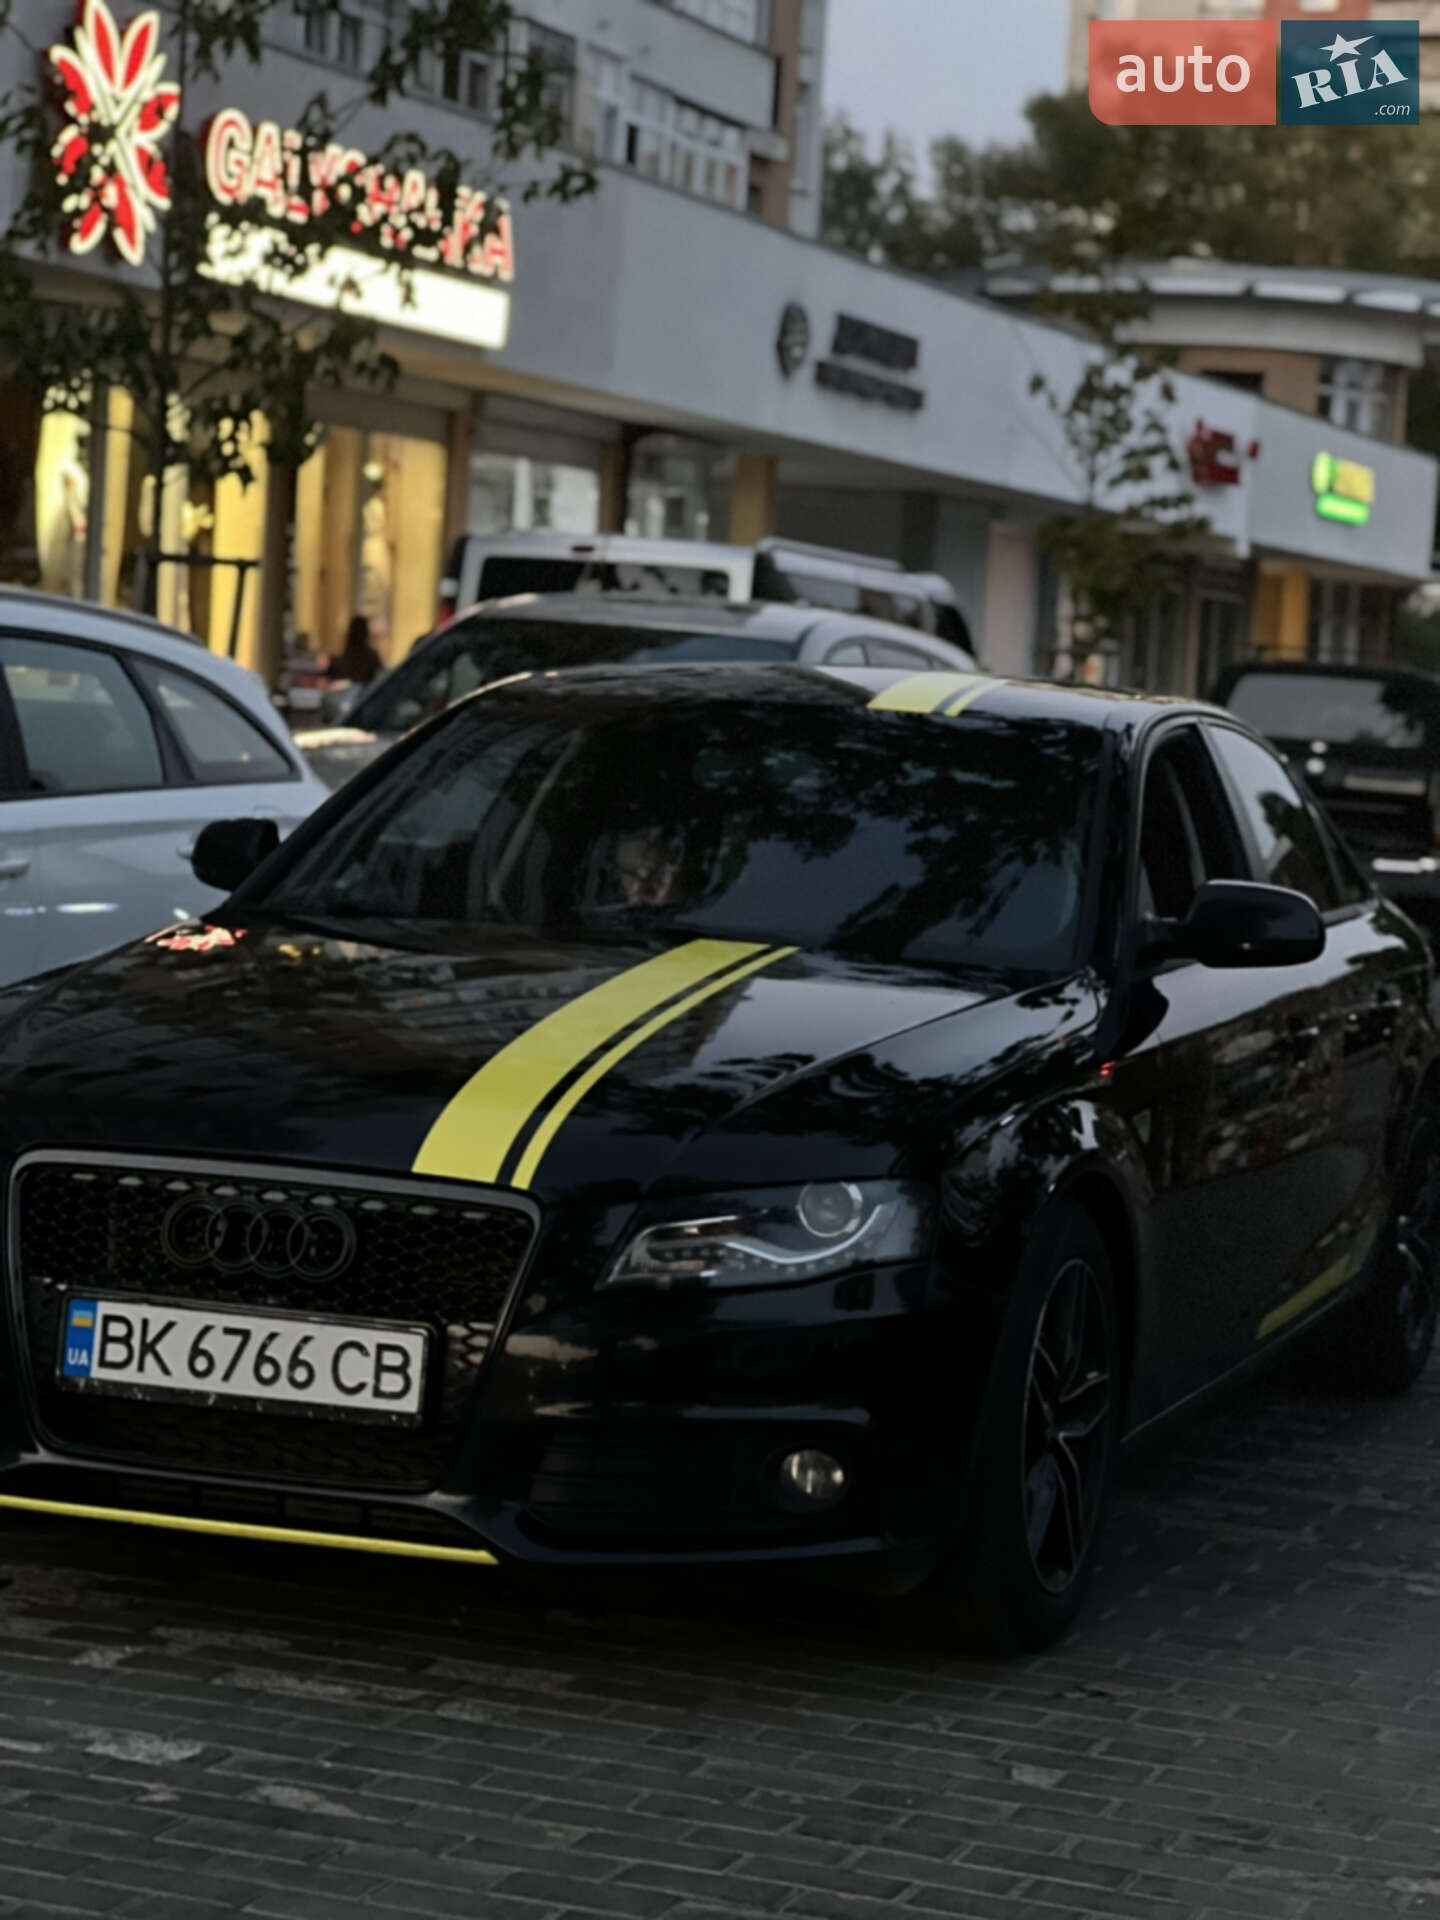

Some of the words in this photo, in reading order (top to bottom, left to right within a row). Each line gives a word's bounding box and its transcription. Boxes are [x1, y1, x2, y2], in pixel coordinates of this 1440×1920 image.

[206, 107, 514, 281] GALYHAKA
[68, 1346, 89, 1366] UA
[98, 1314, 177, 1377] BK
[187, 1325, 316, 1391] 6766
[331, 1340, 413, 1401] CB
